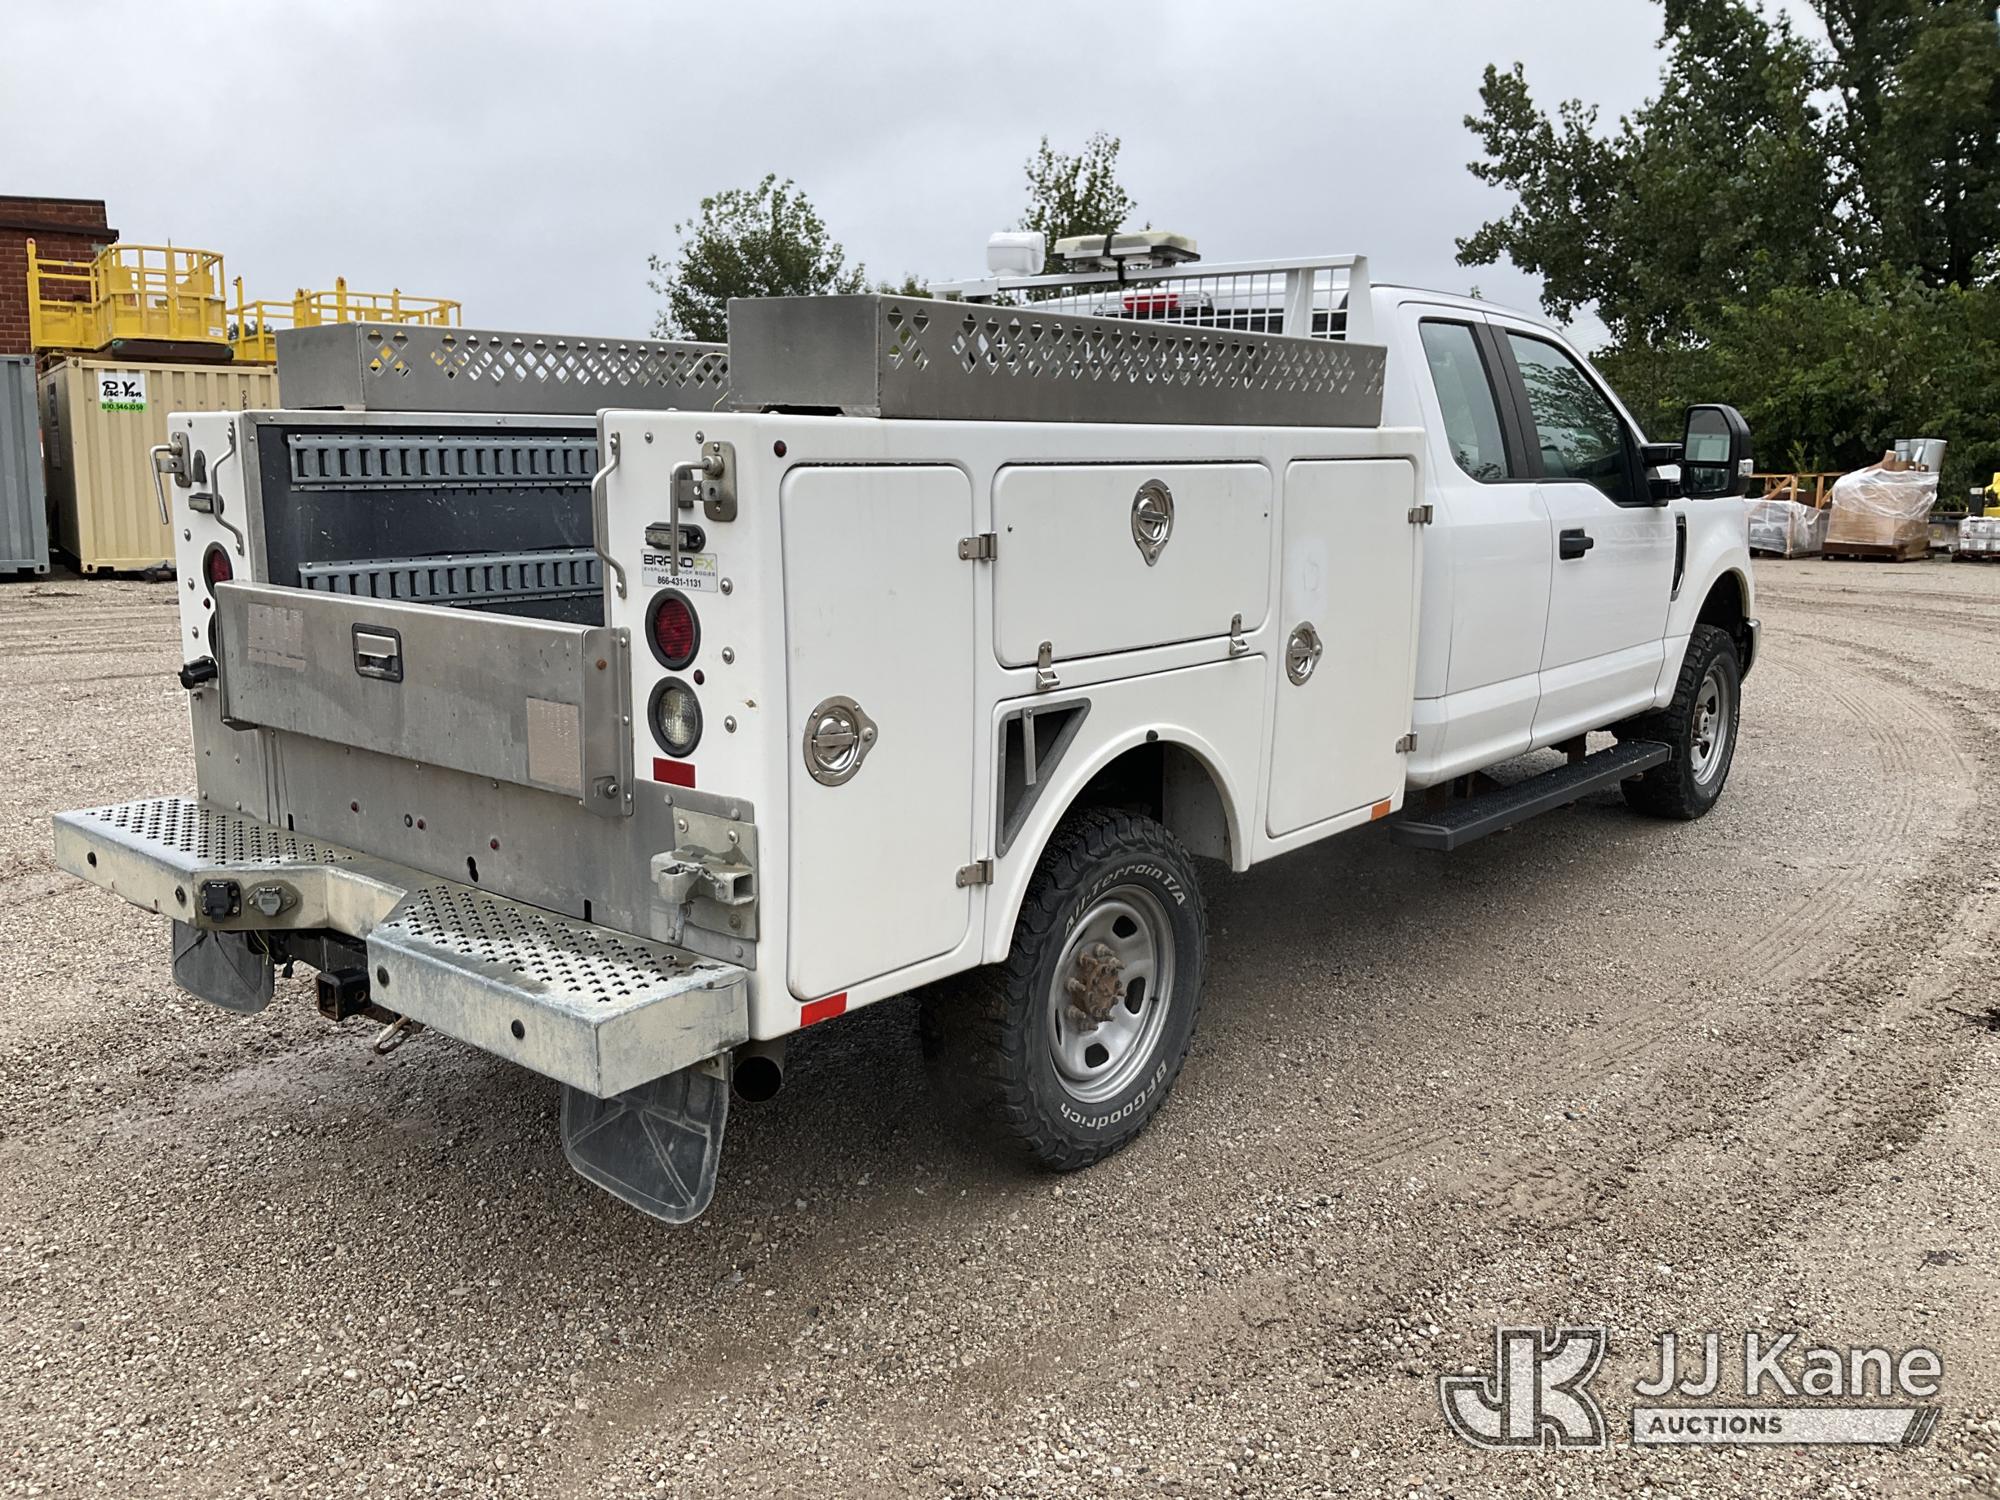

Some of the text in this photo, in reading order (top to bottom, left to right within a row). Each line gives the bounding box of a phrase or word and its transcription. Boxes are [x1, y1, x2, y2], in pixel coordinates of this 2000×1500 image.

[102, 380, 142, 397] Pac-Van
[657, 575, 702, 588] 866-431-1131
[1064, 863, 1187, 938] All-Terrain T/A
[1060, 1059, 1168, 1130] BFGoodrich
